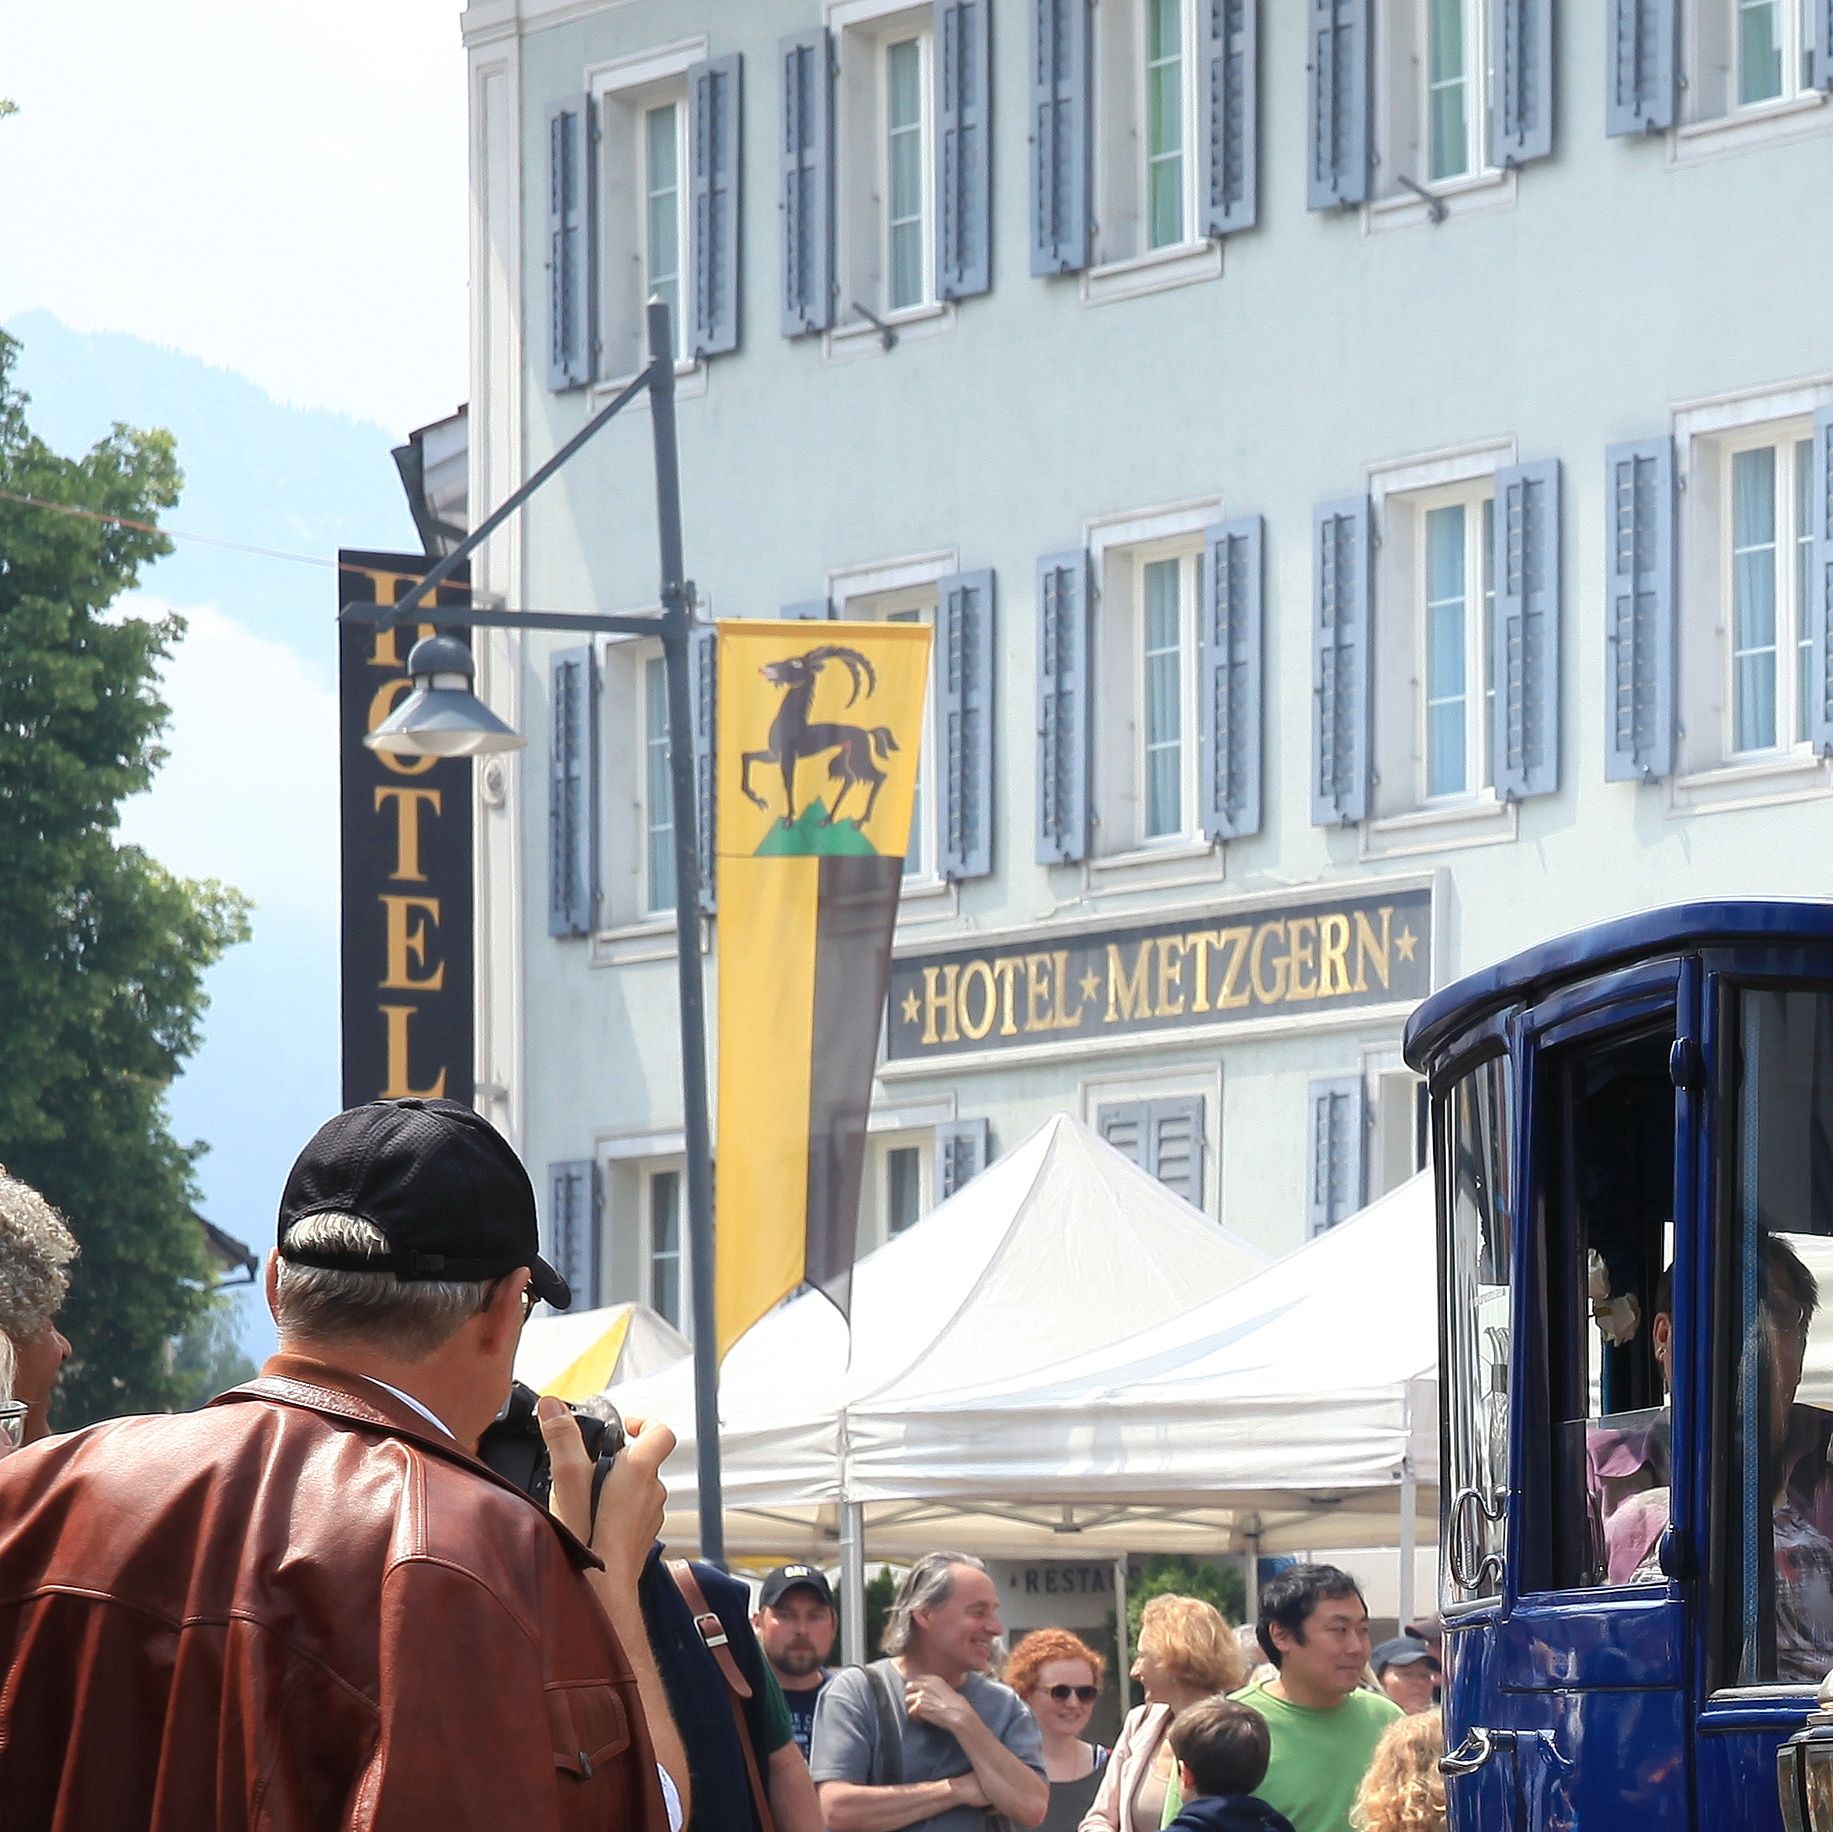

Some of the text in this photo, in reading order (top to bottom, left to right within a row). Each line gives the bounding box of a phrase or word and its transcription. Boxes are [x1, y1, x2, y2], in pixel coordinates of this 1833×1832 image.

[921, 907, 1394, 1044] HOTEL METZGERN
[1024, 1567, 1116, 1593] RESTA
